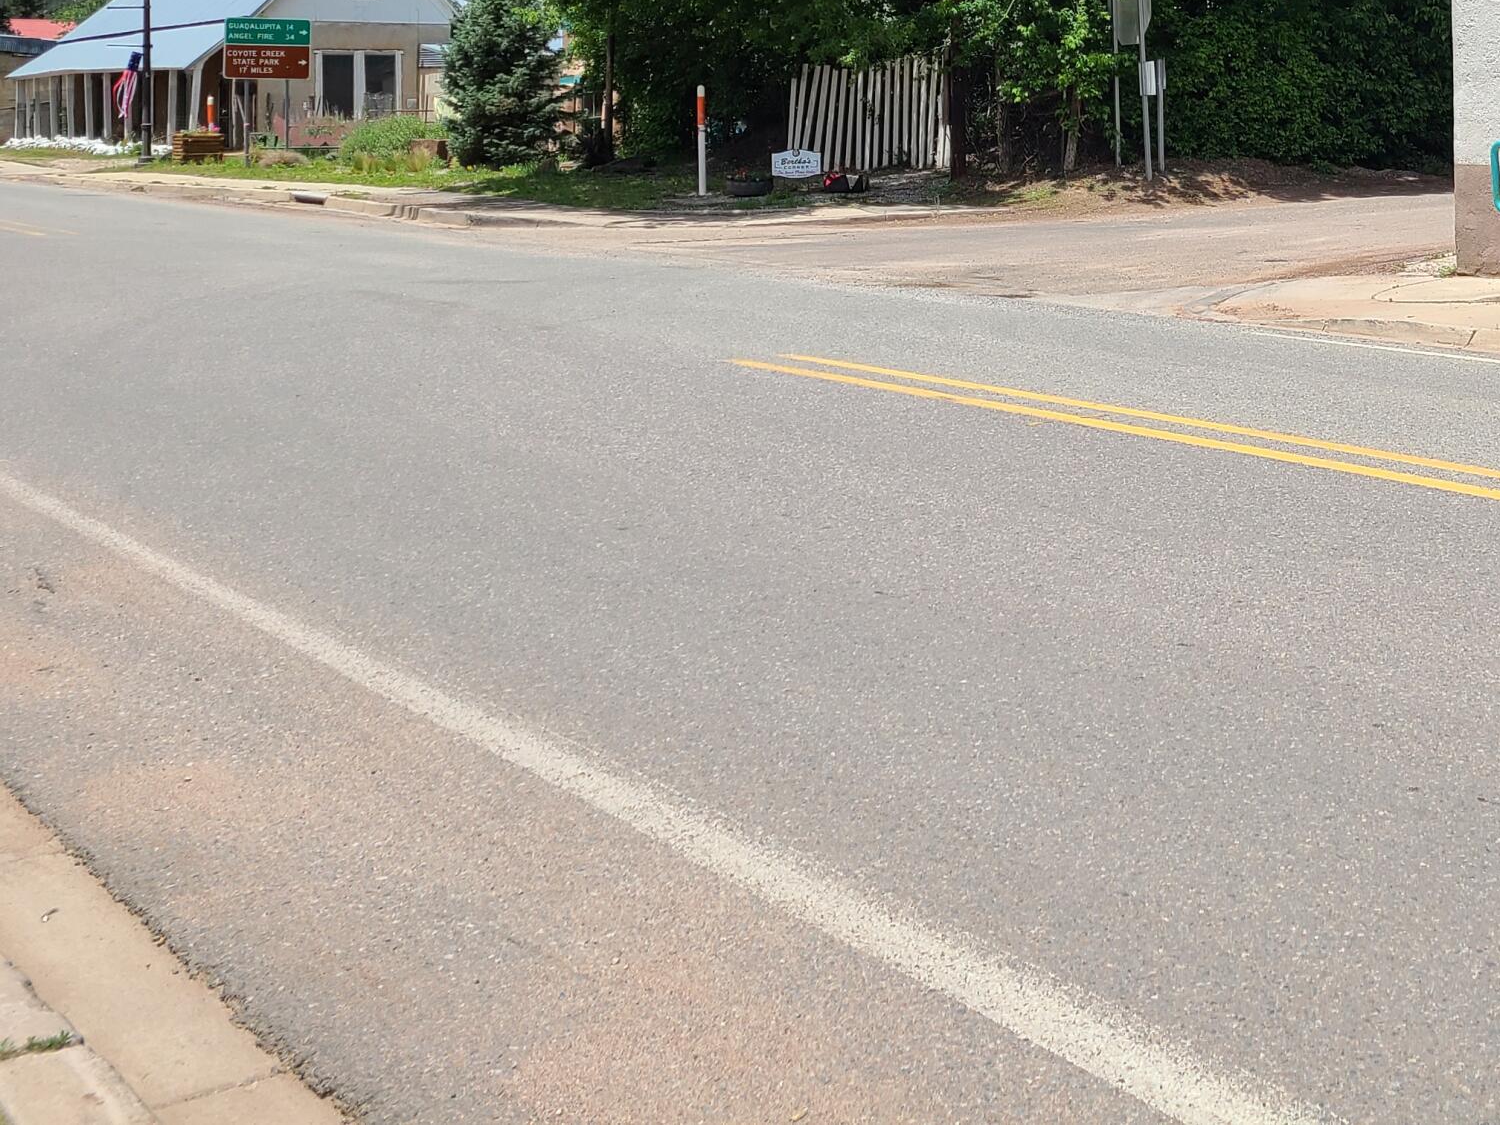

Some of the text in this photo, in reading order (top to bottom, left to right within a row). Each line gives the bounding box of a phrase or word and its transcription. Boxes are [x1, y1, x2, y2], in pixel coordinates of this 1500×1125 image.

[228, 22, 281, 31] GUADALUPITA
[257, 33, 275, 41] FIRE
[261, 50, 286, 58] CREEK
[232, 58, 257, 66] STATE
[781, 157, 811, 165] Bertha's
